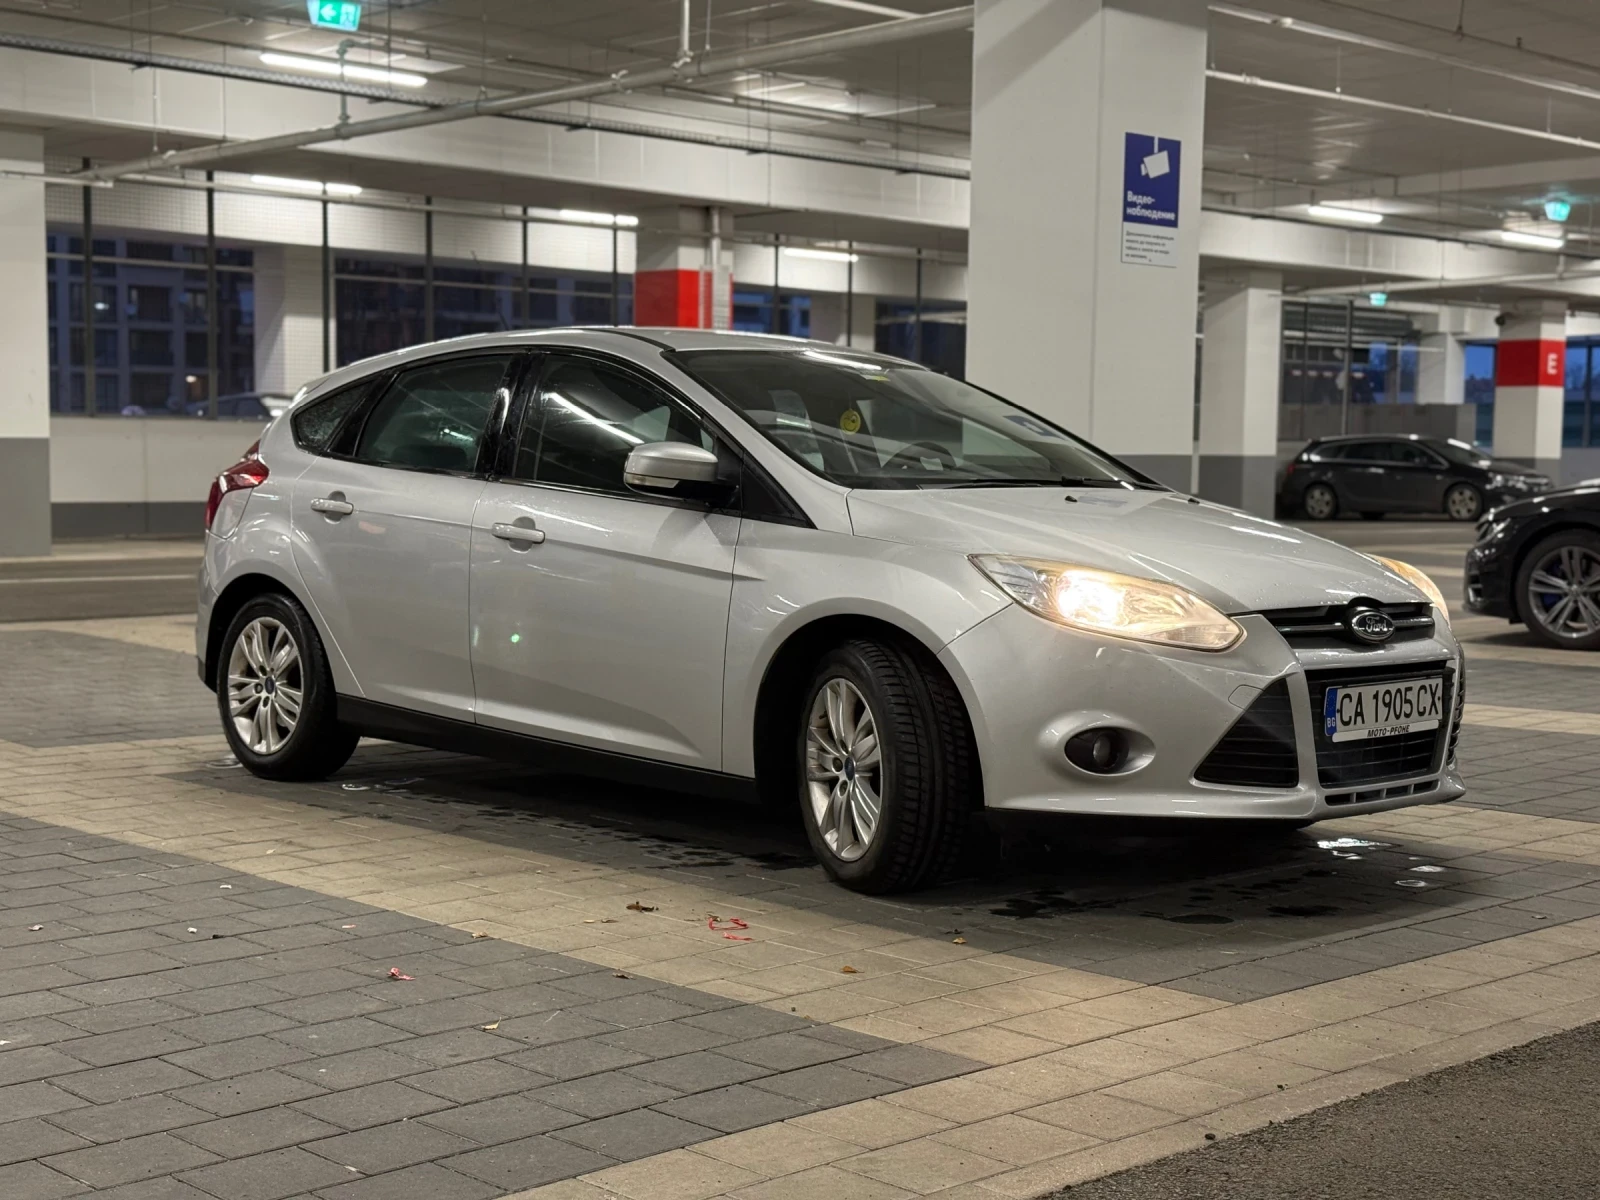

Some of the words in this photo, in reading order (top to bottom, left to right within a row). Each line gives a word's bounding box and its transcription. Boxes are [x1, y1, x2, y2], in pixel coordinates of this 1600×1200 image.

[1127, 190, 1155, 205] Видео-
[1547, 353, 1558, 375] E
[1365, 616, 1388, 632] Ford
[1340, 692, 1365, 727] CA
[1372, 686, 1413, 723] 1905
[1417, 683, 1439, 717] CX
[1326, 717, 1335, 728] BG
[1367, 724, 1410, 738] MOTO-PFOHE
